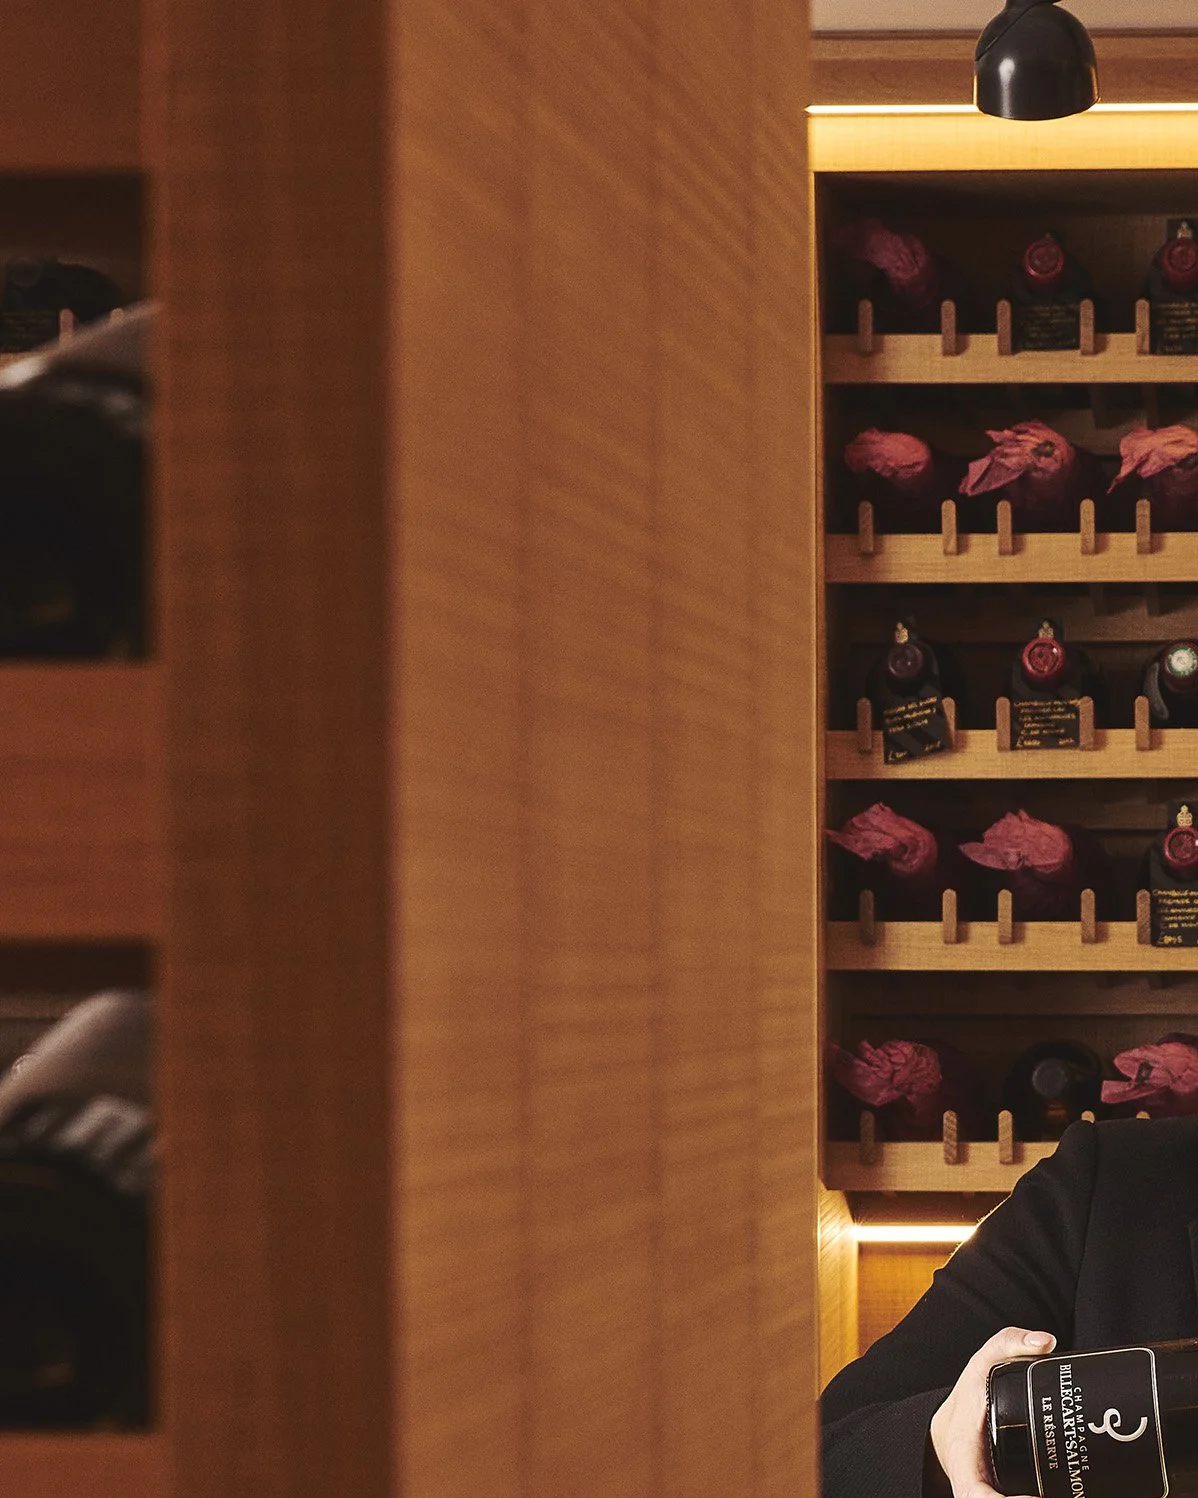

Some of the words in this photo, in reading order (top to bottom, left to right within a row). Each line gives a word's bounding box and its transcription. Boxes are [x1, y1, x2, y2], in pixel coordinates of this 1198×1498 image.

[1041, 1396, 1053, 1412] LE
[1073, 1386, 1090, 1471] CHAMPAGNE
[1043, 1414, 1059, 1470] RÉSERVE
